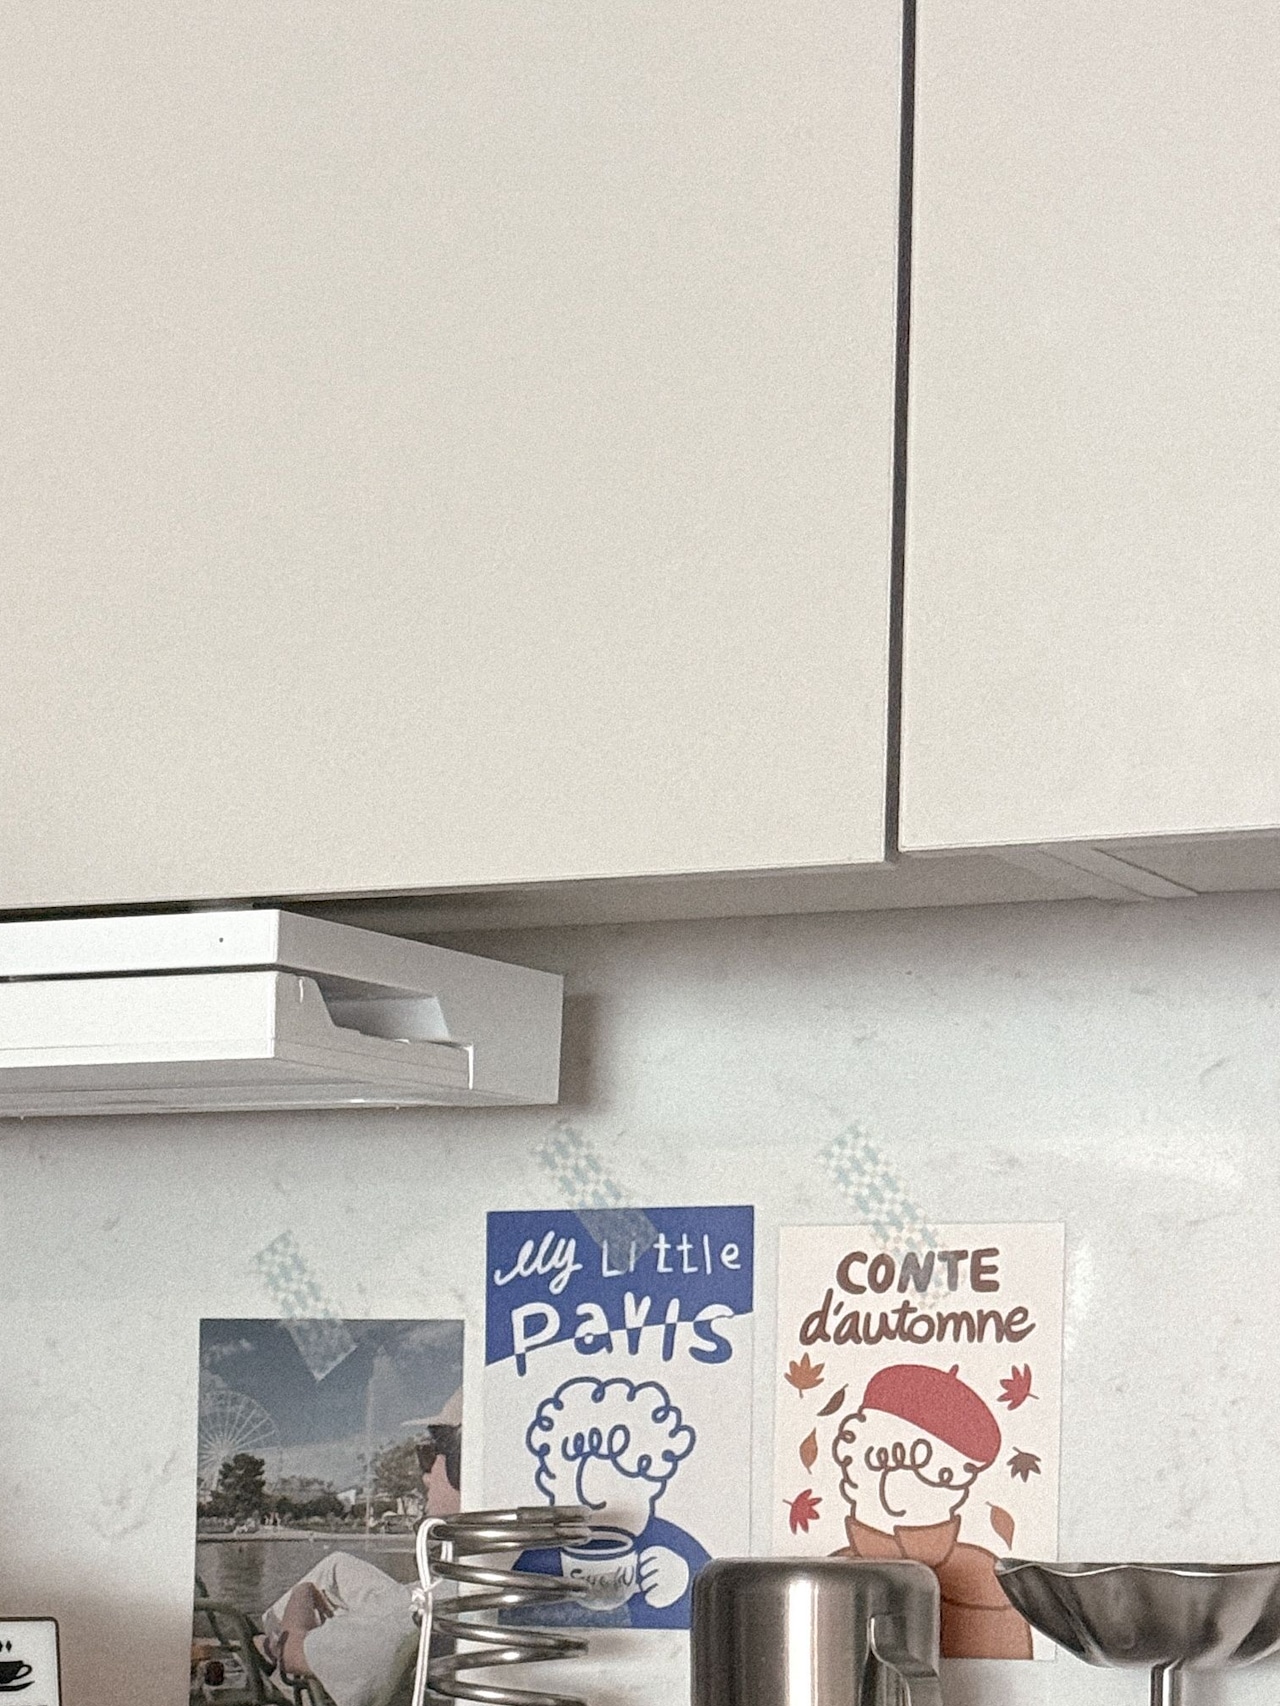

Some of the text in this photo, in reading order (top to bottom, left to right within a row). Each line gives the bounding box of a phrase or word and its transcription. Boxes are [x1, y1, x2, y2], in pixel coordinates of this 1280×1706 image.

[494, 1230, 741, 1295] My Little
[835, 1247, 1001, 1295] CONTE
[798, 1287, 1037, 1346] d'automne
